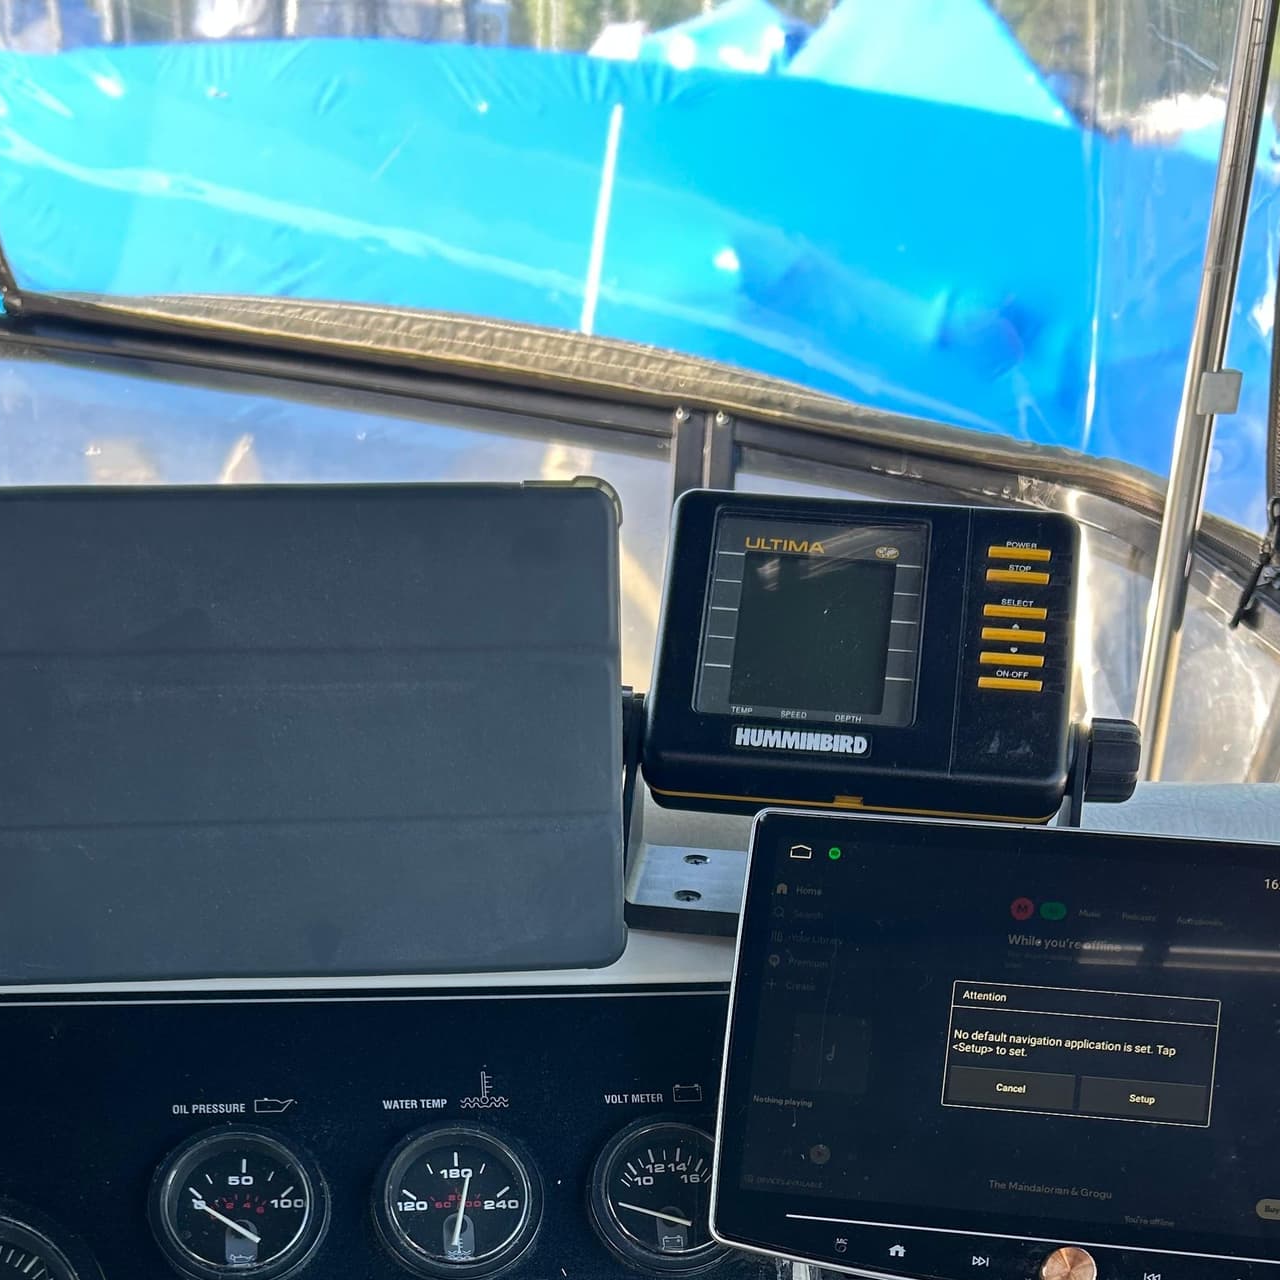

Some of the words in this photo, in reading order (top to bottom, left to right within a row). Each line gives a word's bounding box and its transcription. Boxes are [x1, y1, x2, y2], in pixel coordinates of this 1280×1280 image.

[745, 536, 824, 553] ULTIMA
[1006, 541, 1037, 550] POWER
[1008, 564, 1031, 572] STOP
[1001, 598, 1034, 607] SELECT
[731, 706, 753, 714] TEMP
[780, 710, 808, 719] SPEED
[834, 714, 862, 723] DEPTH
[735, 727, 868, 754] HUMMINBIRD
[1008, 933, 1041, 947] While
[1044, 937, 1081, 950] you're
[962, 989, 1007, 1002] Attention
[954, 1029, 969, 1040] No
[971, 1030, 1007, 1043] default
[1009, 1034, 1063, 1050] navigation
[1065, 1037, 1121, 1053] application
[1123, 1042, 1133, 1052] is
[1134, 1043, 1154, 1054] set.
[1156, 1044, 1177, 1057] Tap
[952, 1042, 994, 1056] <Setup>
[996, 1045, 1007, 1056] to
[1008, 1047, 1028, 1057] set.
[996, 1082, 1027, 1094] Cancel
[383, 1099, 418, 1110] WATER
[420, 1098, 447, 1109] TEMP
[604, 1094, 629, 1104] VOLT
[631, 1093, 664, 1103] METER
[752, 1094, 783, 1106] Nothing
[784, 1097, 813, 1109] playing
[1129, 1093, 1155, 1106] Setup
[172, 1104, 189, 1114] OIL
[192, 1103, 246, 1114] PRESSURE
[645, 1163, 665, 1174] 12
[667, 1162, 688, 1172] 14
[439, 1168, 473, 1179] 180
[680, 1174, 700, 1184] 16
[228, 1175, 254, 1186] 50
[633, 1176, 654, 1186] 10
[989, 1179, 1006, 1190] The
[1071, 1187, 1079, 1196] &
[1080, 1187, 1113, 1200] Grogu
[270, 1199, 305, 1209] 100
[397, 1201, 428, 1212] 120
[483, 1199, 519, 1210] 240
